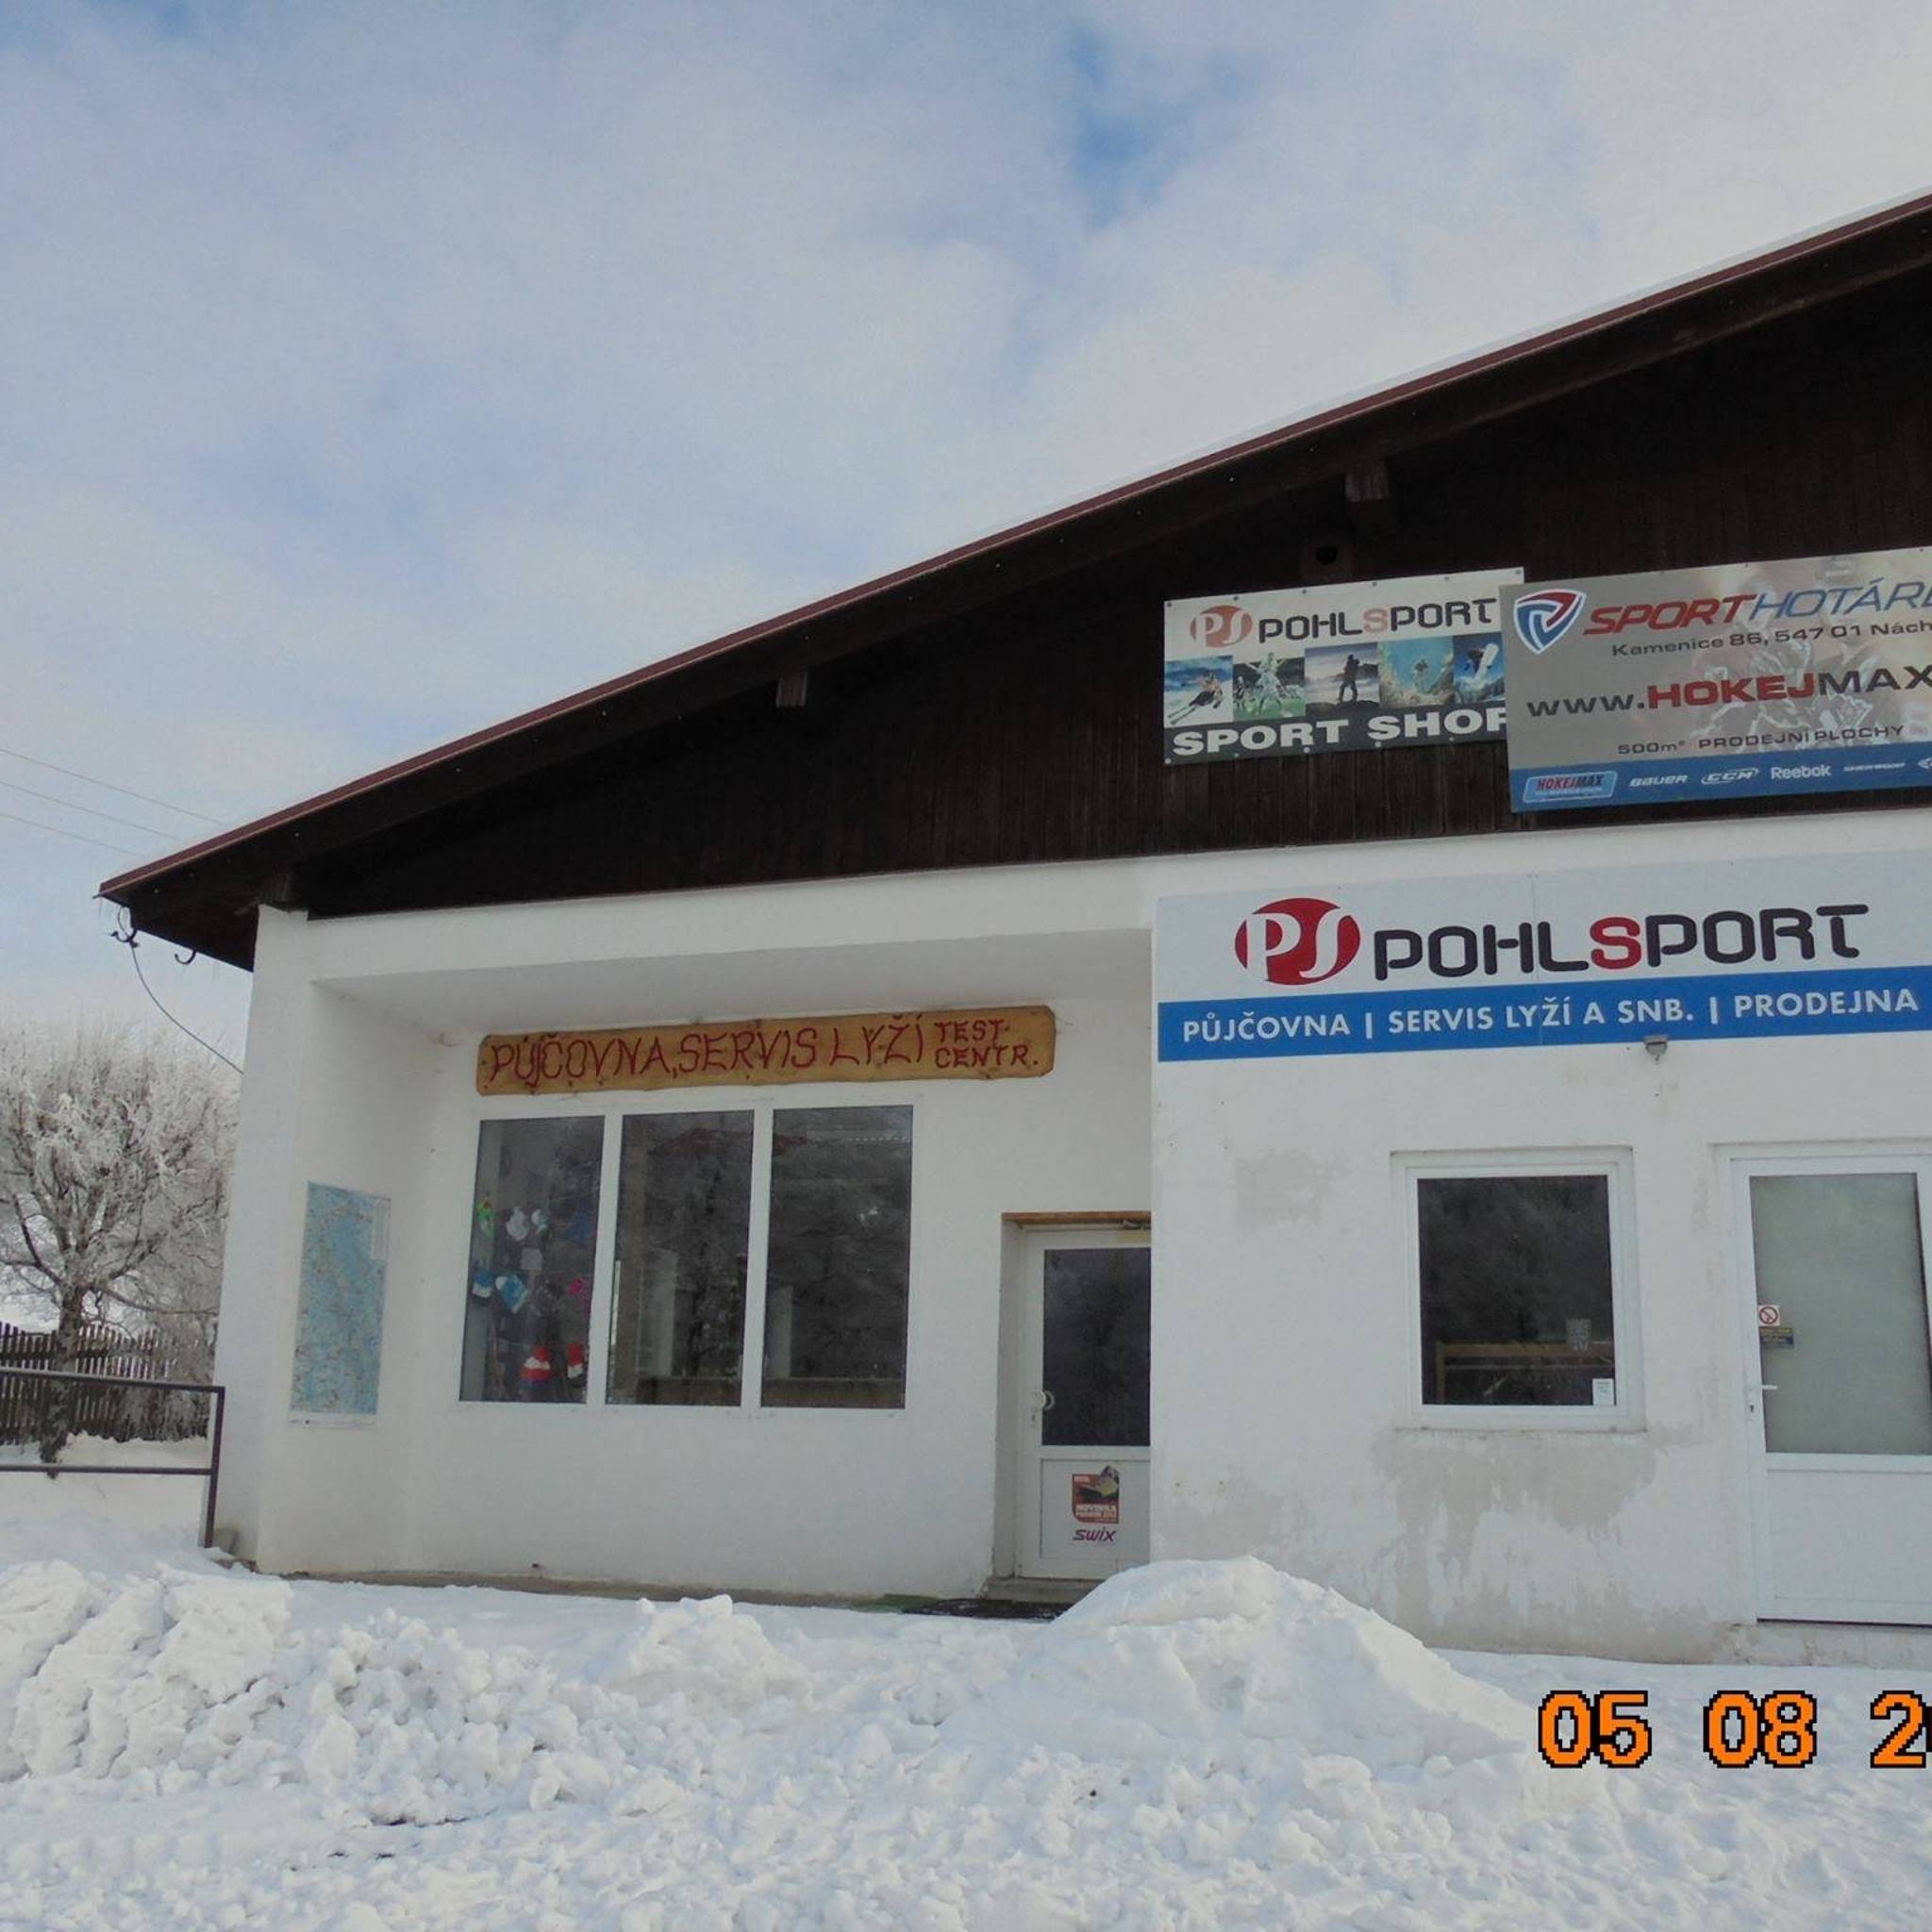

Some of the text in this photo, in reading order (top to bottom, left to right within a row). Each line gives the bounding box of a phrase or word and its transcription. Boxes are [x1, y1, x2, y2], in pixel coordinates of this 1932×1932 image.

[1257, 597, 1497, 643] POHLSPORT
[1611, 638, 1724, 657] Kamenice
[1729, 631, 1769, 647] 86,
[1774, 625, 1824, 642] 547
[1830, 625, 1861, 639] 01
[1172, 719, 1349, 756] SPORT
[1813, 724, 1905, 742] PLOCHY
[1770, 764, 1832, 780] Reebok
[1374, 903, 1870, 982] POHLSPORT
[1183, 1010, 1351, 1042] PŮJČOVNA
[1388, 1006, 1494, 1034] SERVIS
[1506, 996, 1571, 1029] LYŽÍ
[1582, 1001, 1606, 1024] A
[1617, 998, 1694, 1024] SNB.
[1734, 988, 1920, 1019] PRODEJNA
[829, 1014, 924, 1067] LYŽÍ
[934, 1044, 1039, 1069] CENTR.
